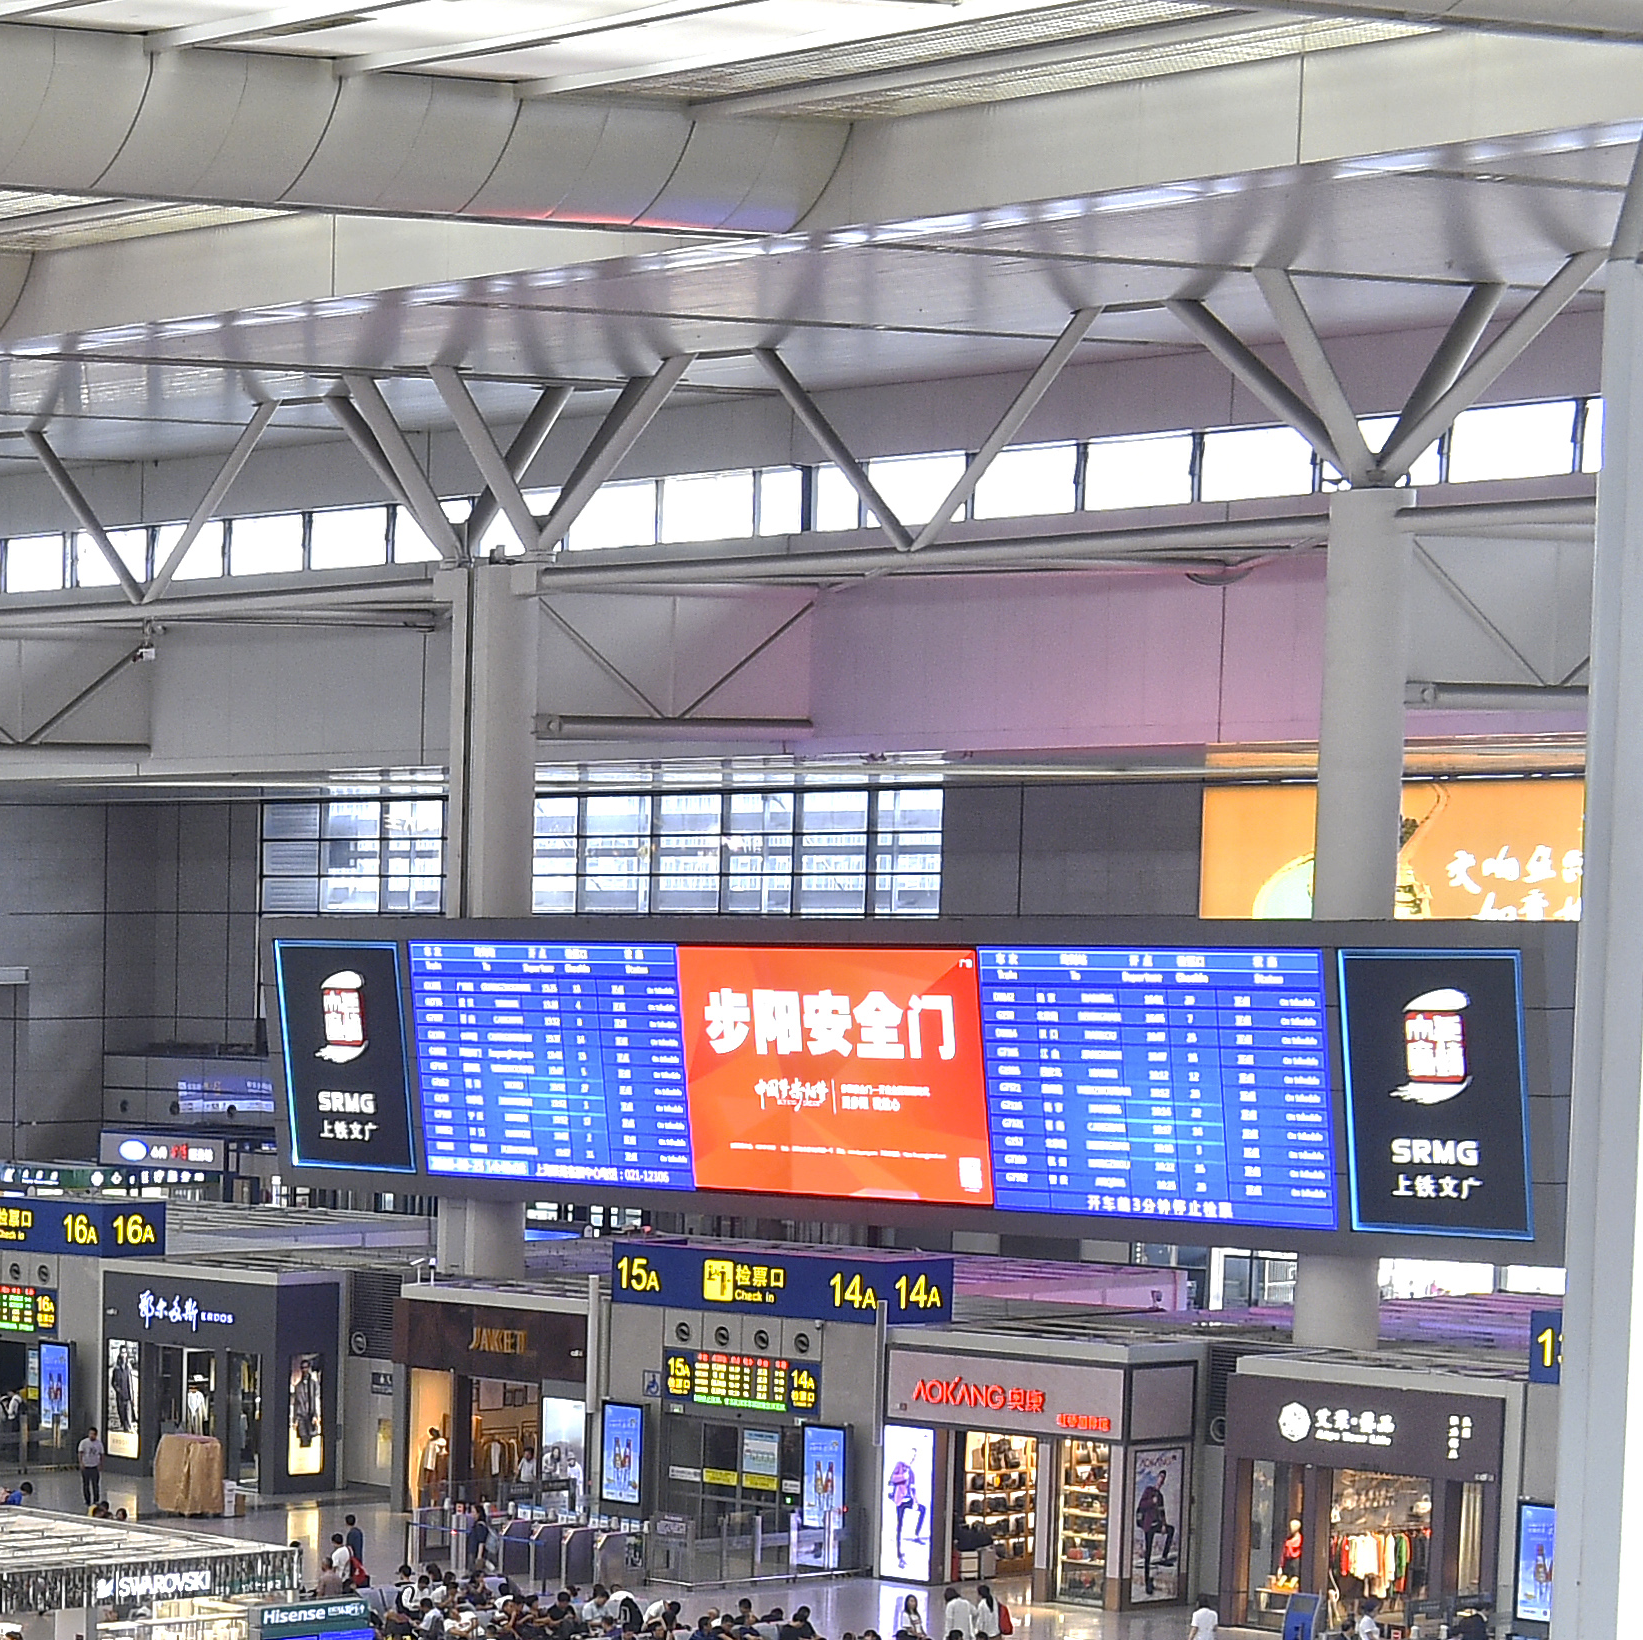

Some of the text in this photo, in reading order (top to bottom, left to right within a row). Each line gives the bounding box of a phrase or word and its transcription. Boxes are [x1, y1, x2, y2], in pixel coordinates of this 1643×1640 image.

[704, 988, 955, 1060] 步阳安全门
[318, 1091, 375, 1114] SRMG
[320, 1120, 379, 1141] 上铁文广
[1391, 1138, 1479, 1166] SRMG
[1392, 1174, 1483, 1199] 上铁文广
[64, 1213, 97, 1244] 16A
[113, 1214, 154, 1244] 16A
[617, 1256, 660, 1292] 15A
[735, 1265, 785, 1289] 检票口
[735, 1291, 775, 1303] Check in
[830, 1273, 877, 1309] 14A
[895, 1274, 942, 1310] 14A
[139, 1290, 198, 1331] 鄂尔多斯
[201, 1312, 234, 1323] ERDOS
[668, 1356, 690, 1377] 15A
[791, 1370, 815, 1390] 14A
[913, 1376, 1045, 1413] AOKANG 奥康
[119, 1571, 210, 1598] SWAROVSKI
[263, 1607, 325, 1624] Hisense
